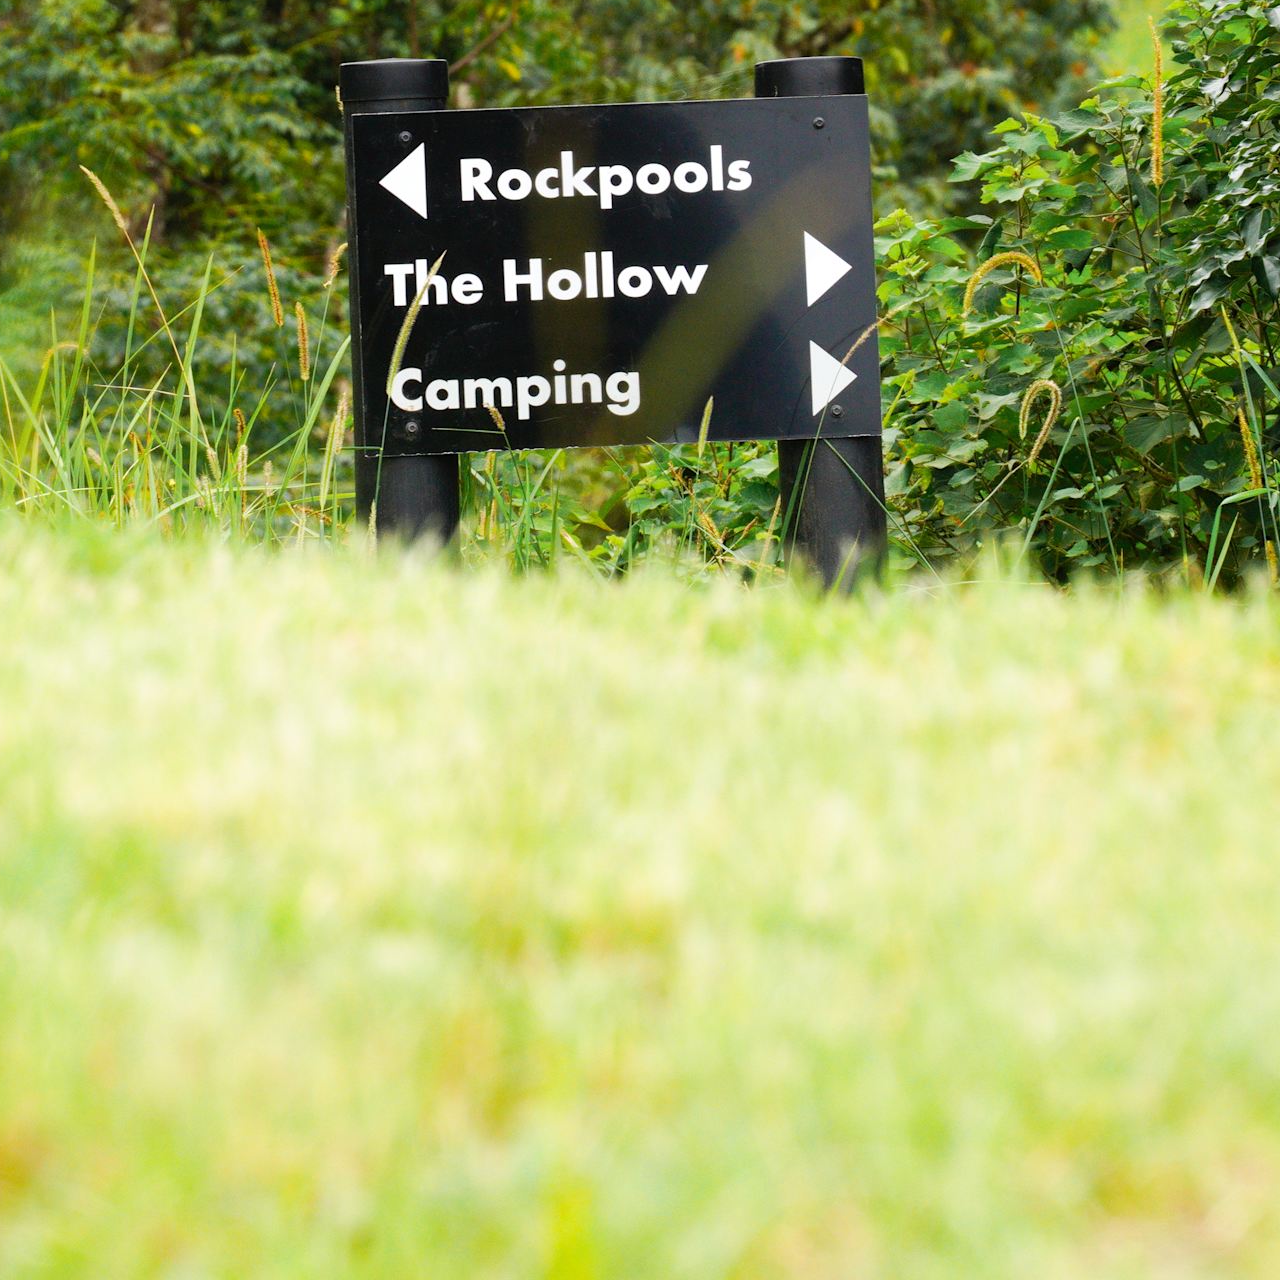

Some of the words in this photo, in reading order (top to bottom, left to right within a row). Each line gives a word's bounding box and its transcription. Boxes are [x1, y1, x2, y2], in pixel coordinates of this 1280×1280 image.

[460, 145, 753, 209] Rockpools
[385, 258, 483, 306] The
[503, 251, 708, 302] Hollow
[390, 359, 640, 420] Camping
